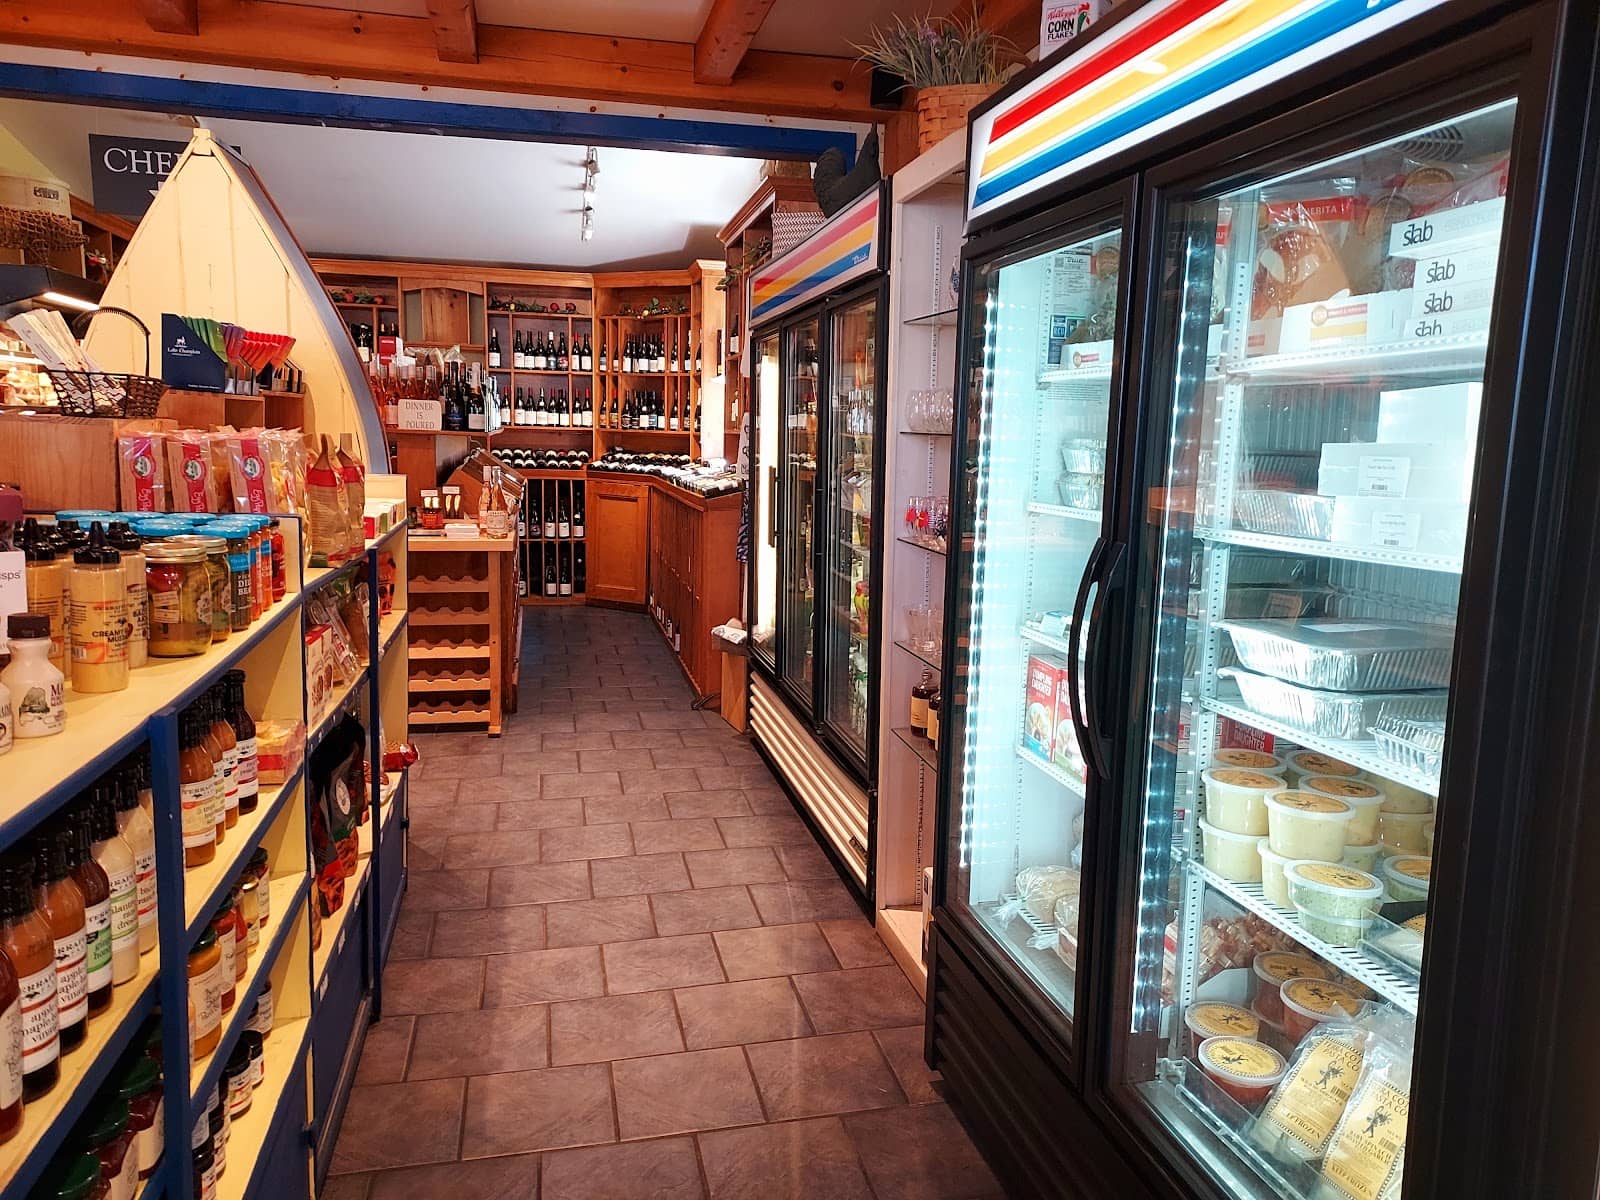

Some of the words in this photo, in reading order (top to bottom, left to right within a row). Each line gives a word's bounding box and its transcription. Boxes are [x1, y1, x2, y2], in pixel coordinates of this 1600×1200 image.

[1047, 18, 1075, 33] CORN
[1047, 31, 1074, 40] FLAKES
[1402, 220, 1433, 246] slab
[1426, 259, 1456, 284] slab
[1423, 291, 1453, 315] slab
[405, 401, 434, 411] DINNER
[416, 412, 423, 420] IS
[406, 421, 435, 430] POURED
